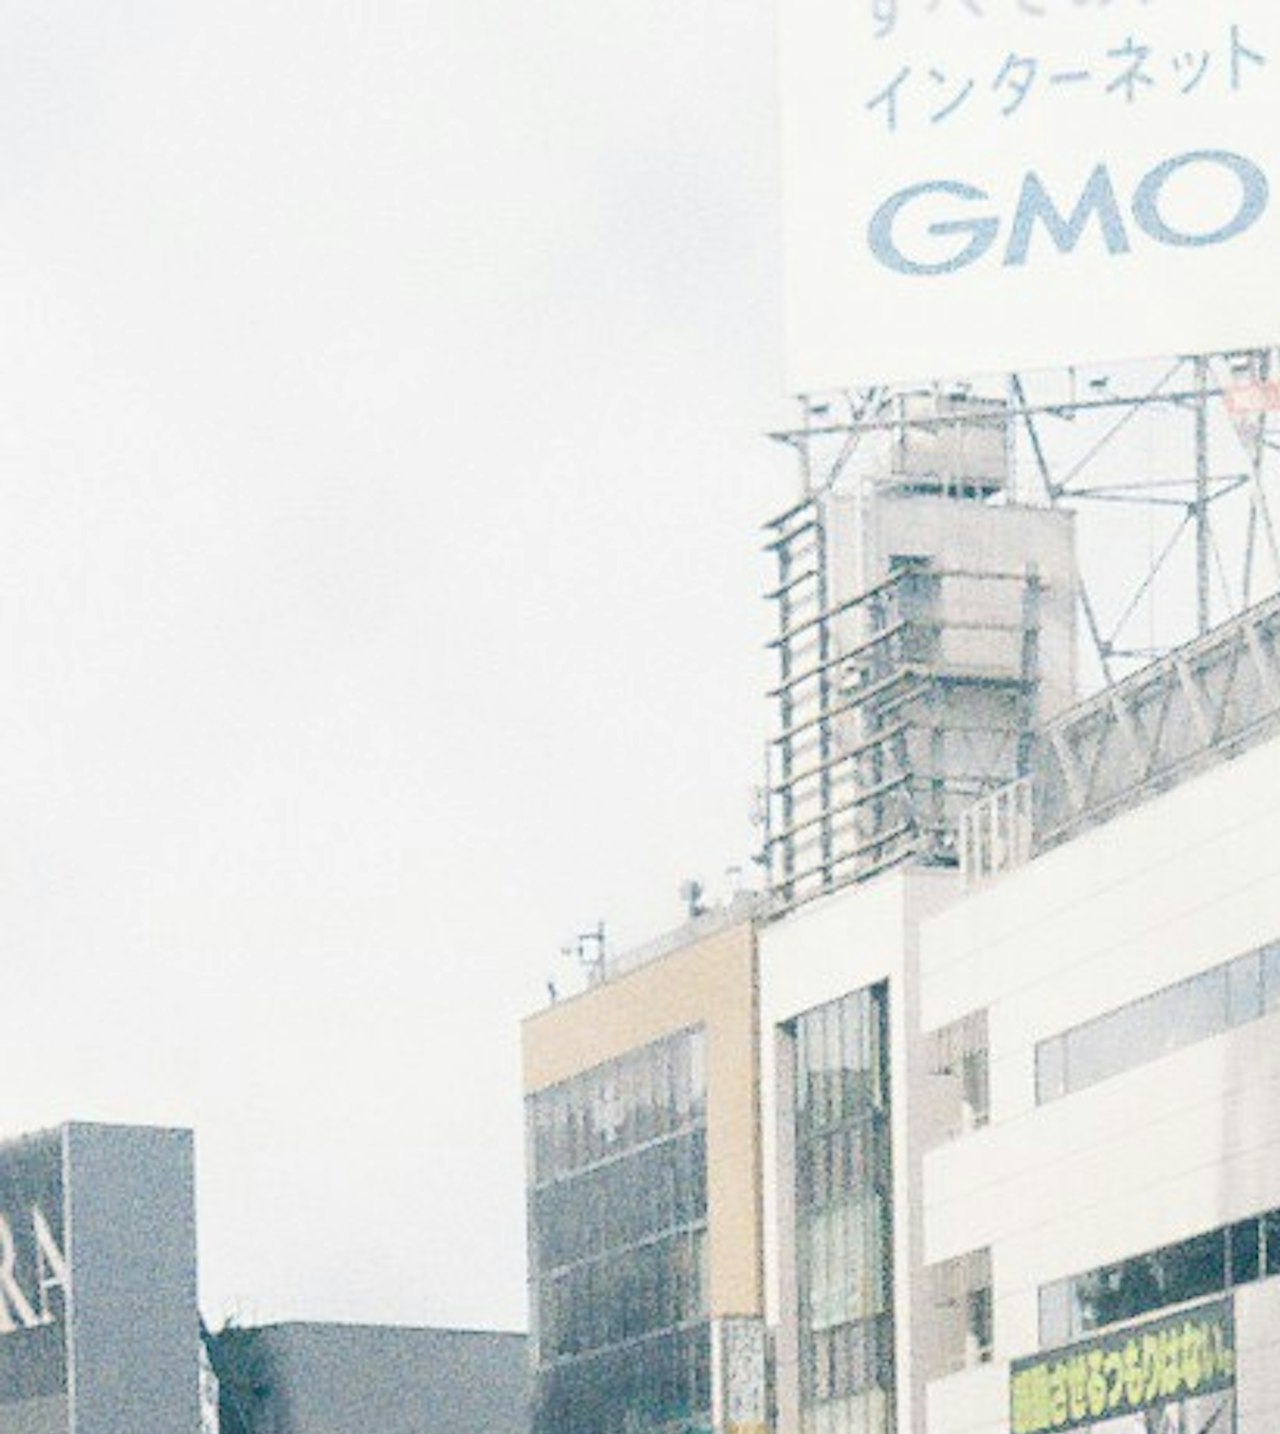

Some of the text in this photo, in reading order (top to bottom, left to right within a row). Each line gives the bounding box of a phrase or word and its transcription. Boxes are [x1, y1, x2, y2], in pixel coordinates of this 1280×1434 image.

[865, 24, 1266, 131] インターネット
[866, 149, 1270, 275] GMO
